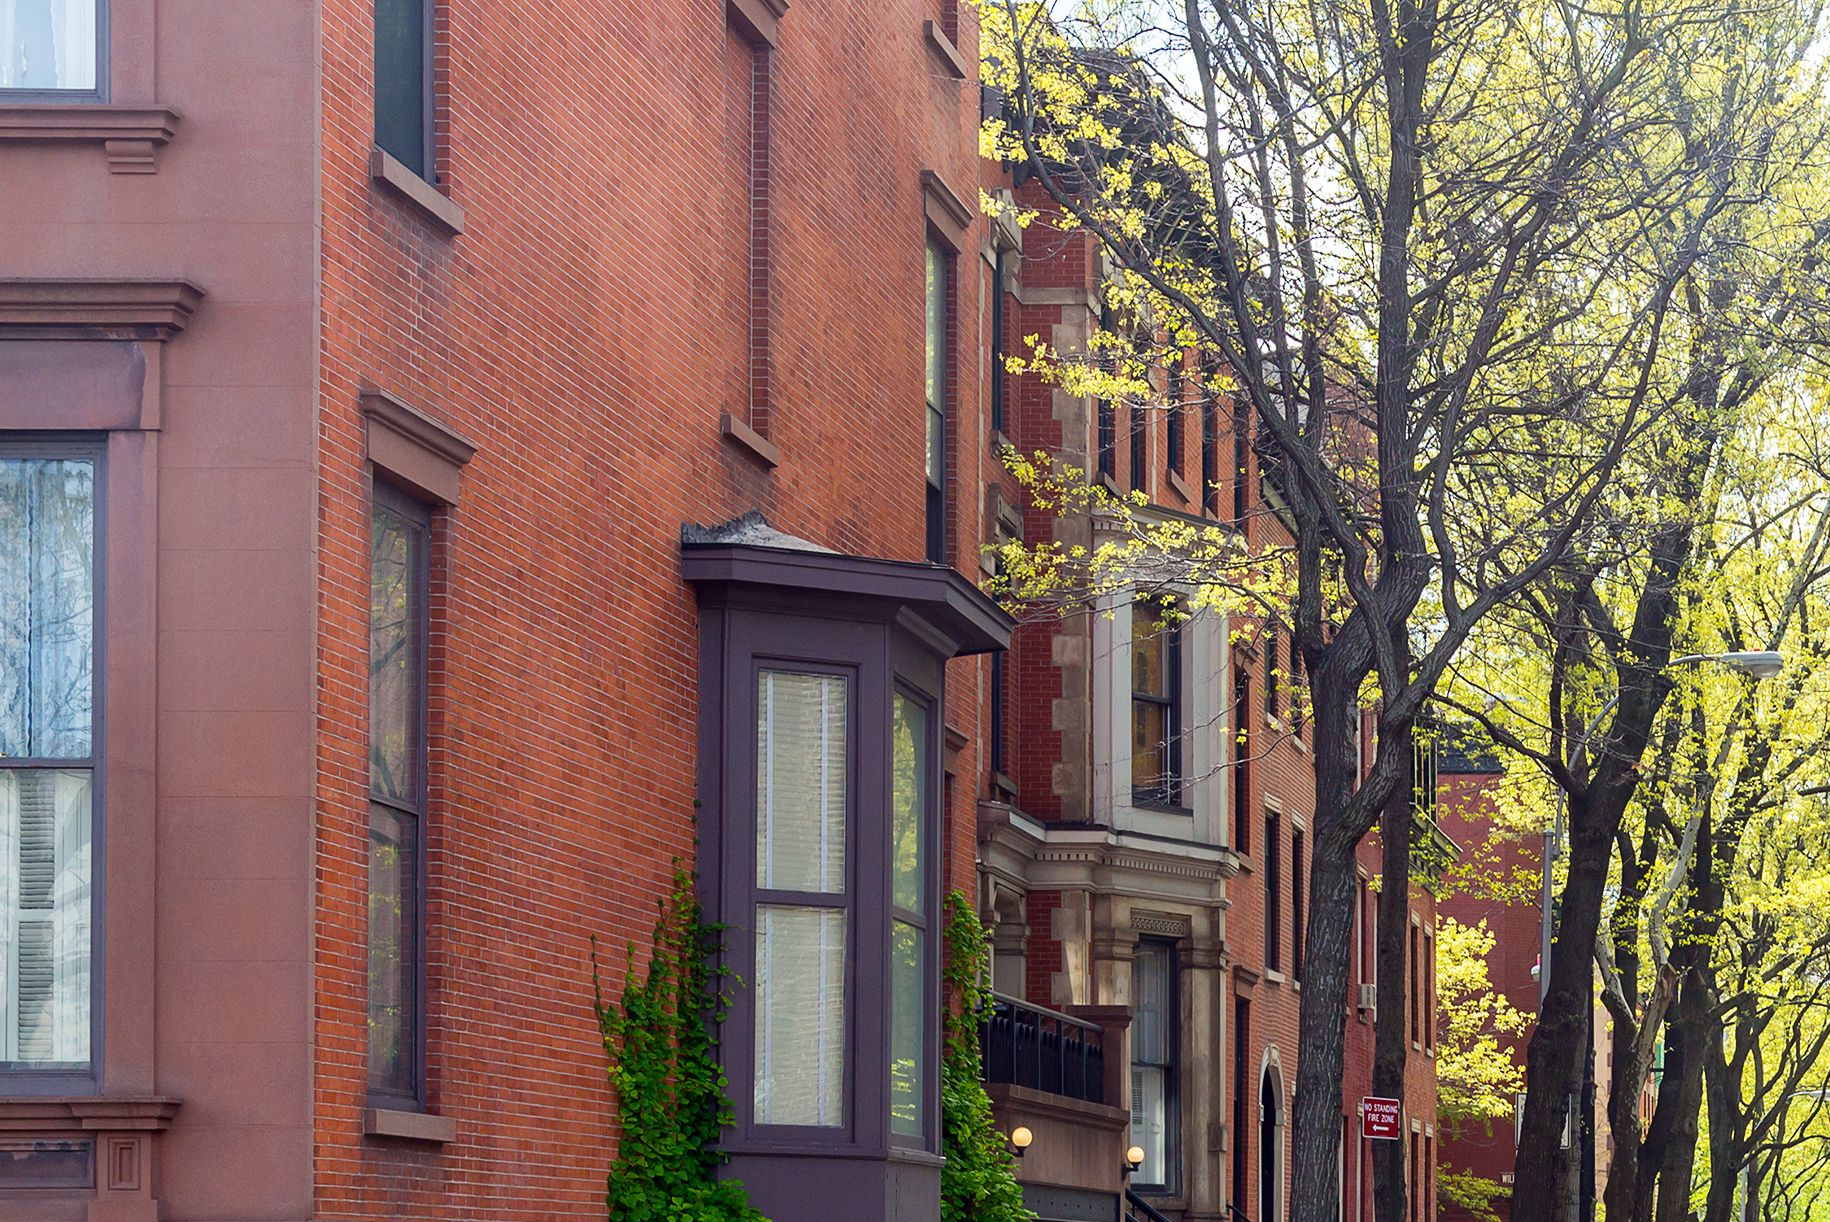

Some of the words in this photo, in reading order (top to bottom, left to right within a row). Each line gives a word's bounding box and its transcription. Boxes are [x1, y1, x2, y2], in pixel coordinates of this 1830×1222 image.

[1364, 1103, 1373, 1111] NO
[1374, 1103, 1398, 1114] STANDING
[1368, 1113, 1380, 1122] FIRE
[1381, 1114, 1395, 1124] ZONE
